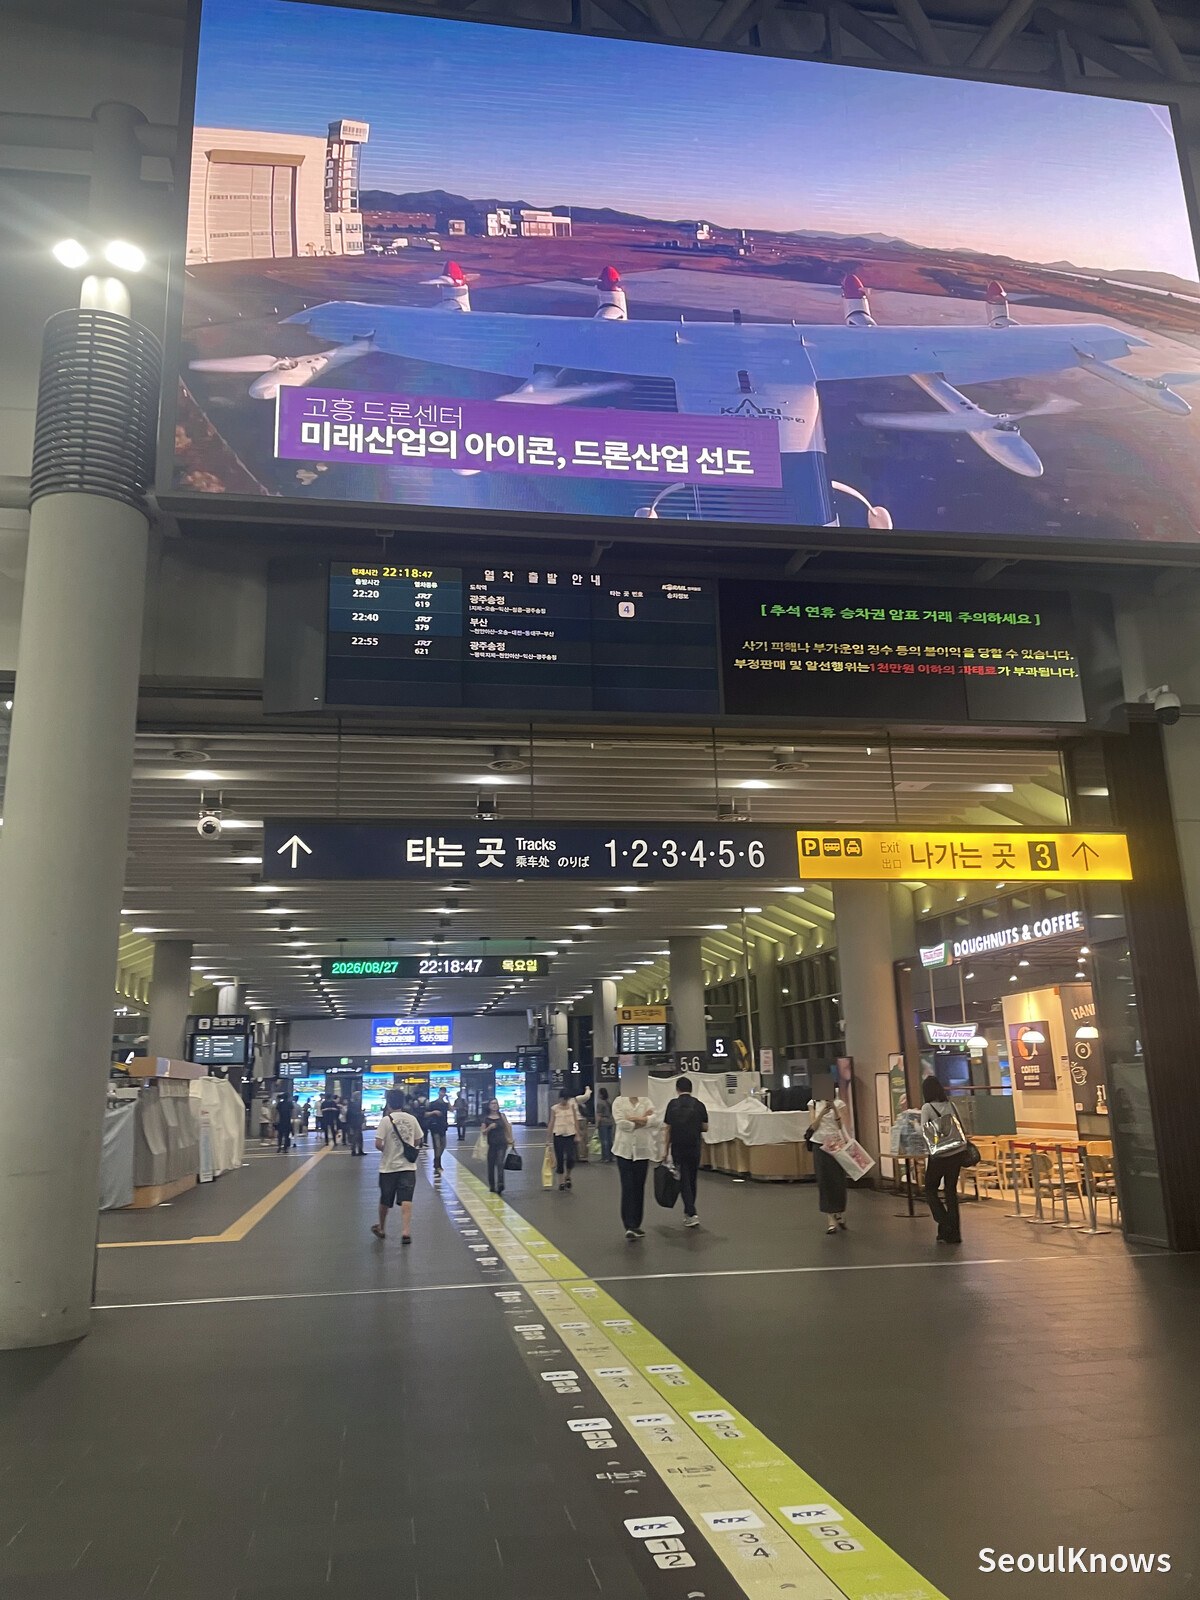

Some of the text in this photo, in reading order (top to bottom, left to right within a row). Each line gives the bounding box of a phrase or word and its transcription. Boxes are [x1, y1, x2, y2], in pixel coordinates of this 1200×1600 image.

[303, 397, 463, 430] 고흥 드론센터
[301, 421, 755, 476] 미래산업의 아이콘, 드론산업 선도
[382, 567, 433, 578] 22:18:47
[352, 589, 380, 598] 22:20
[469, 595, 505, 605] 광주송정
[351, 613, 379, 622] 22:40
[770, 604, 801, 617] 추석
[805, 606, 836, 618] 연휴
[840, 607, 886, 620] 승차권
[889, 608, 920, 621] 암표
[923, 610, 953, 622] 거래
[957, 612, 1032, 625] 주의하세요
[469, 618, 488, 627] 부산
[351, 637, 379, 646] 22:55
[469, 641, 506, 652] 광주송정
[742, 640, 1074, 661] 사기 피해나 부가운임 징수 등의 불이익을 당할 수 있습니다.
[734, 659, 786, 671] 부정판매
[789, 660, 802, 671] 및
[917, 664, 956, 675] 이하의
[1013, 666, 1079, 678] 부과됩니다.
[515, 837, 557, 852] Tracks
[880, 841, 900, 854] Exit
[405, 837, 506, 868] 타는 곳
[910, 842, 1052, 870] 나가는 곳 3
[557, 856, 590, 869] のりば
[882, 858, 902, 870] 出口
[953, 910, 1081, 958] DOUGHNUTS & COFFEE
[331, 960, 399, 975] 2026/08/27
[418, 959, 483, 974] 22:18:47
[501, 959, 538, 974] 목요일
[715, 1039, 725, 1054] 5
[572, 1062, 579, 1071] 5
[573, 1420, 604, 1428] KTX
[635, 1416, 665, 1424] KTX
[713, 1514, 751, 1524] KTX
[792, 1508, 829, 1518] KTX
[633, 1521, 672, 1531] KTX
[820, 1525, 840, 1537] 5
[738, 1532, 760, 1544] 3
[656, 1540, 670, 1551] 1
[833, 1540, 855, 1552] 6
[753, 1547, 770, 1558] 4
[664, 1554, 686, 1567] 2
